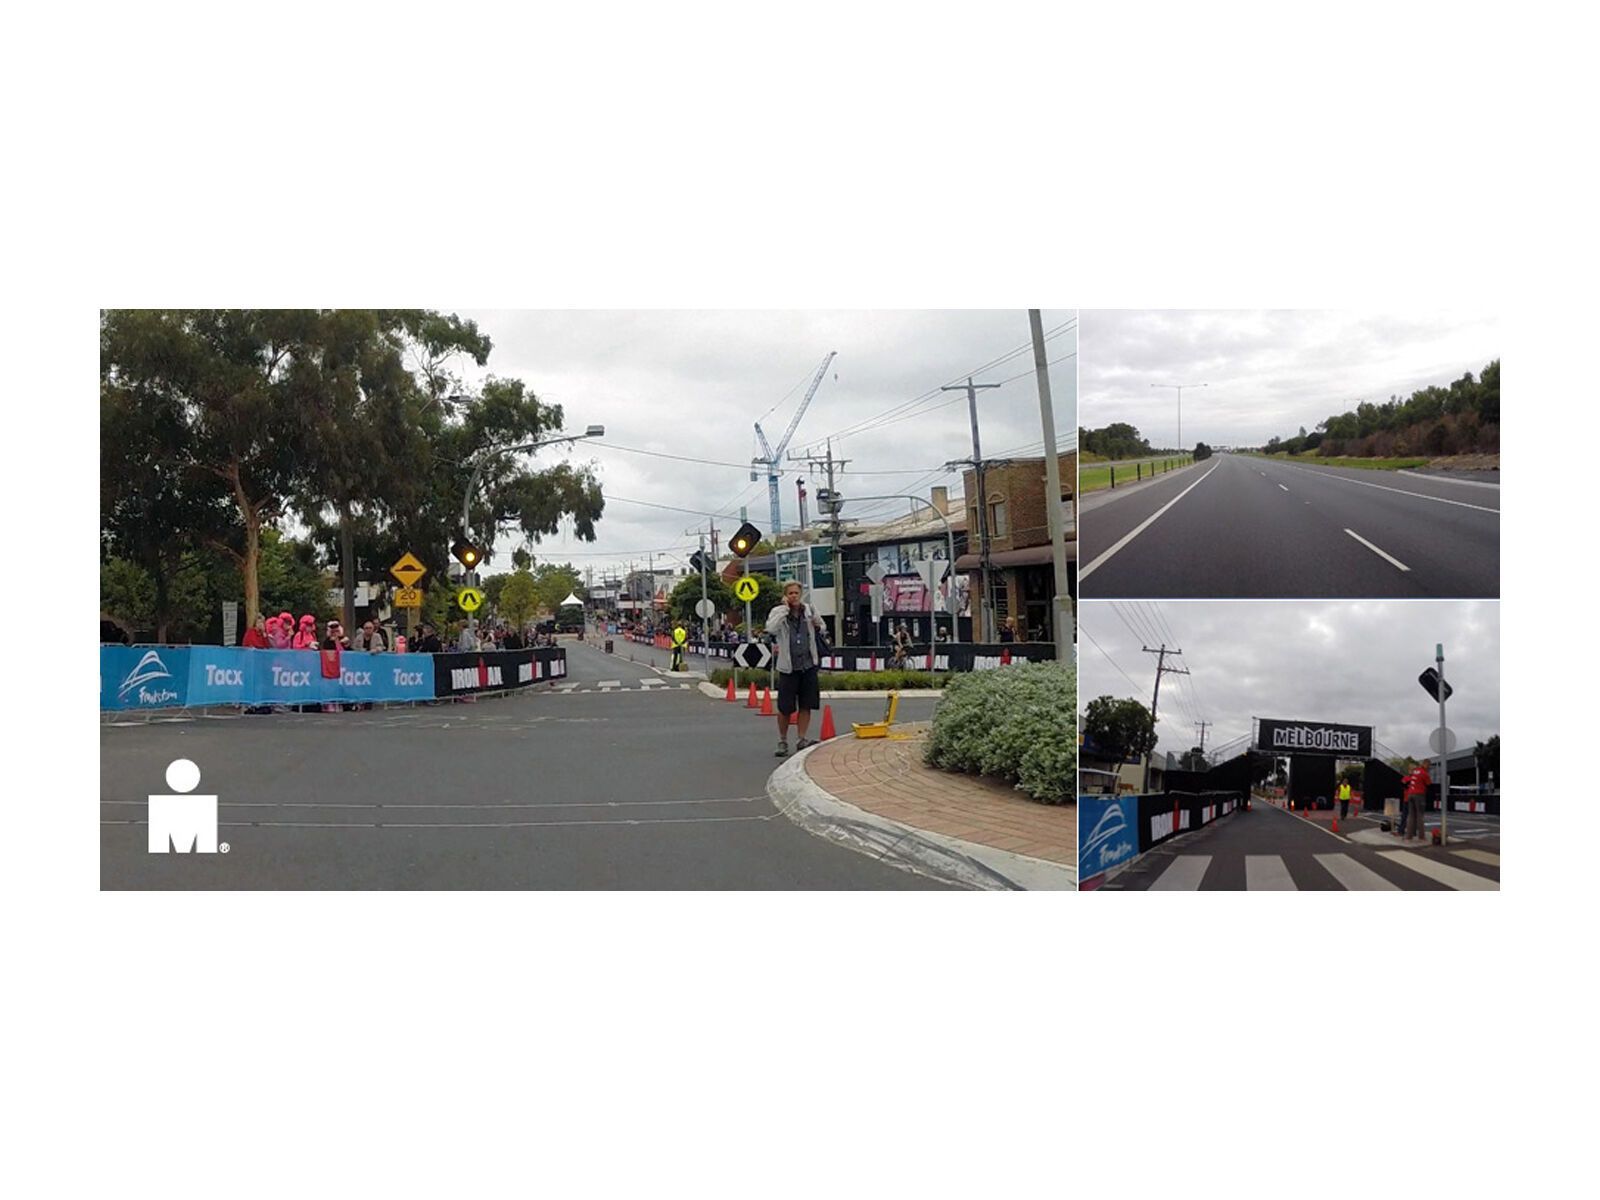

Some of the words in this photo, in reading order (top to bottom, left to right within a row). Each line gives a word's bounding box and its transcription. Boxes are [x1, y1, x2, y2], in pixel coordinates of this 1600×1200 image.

[401, 590, 417, 600] 20
[205, 664, 244, 686] Tacx
[271, 667, 311, 687] Tacx
[338, 667, 372, 686] Tacx
[393, 668, 424, 686] Tacx
[1273, 726, 1359, 750] MELBOURNE
